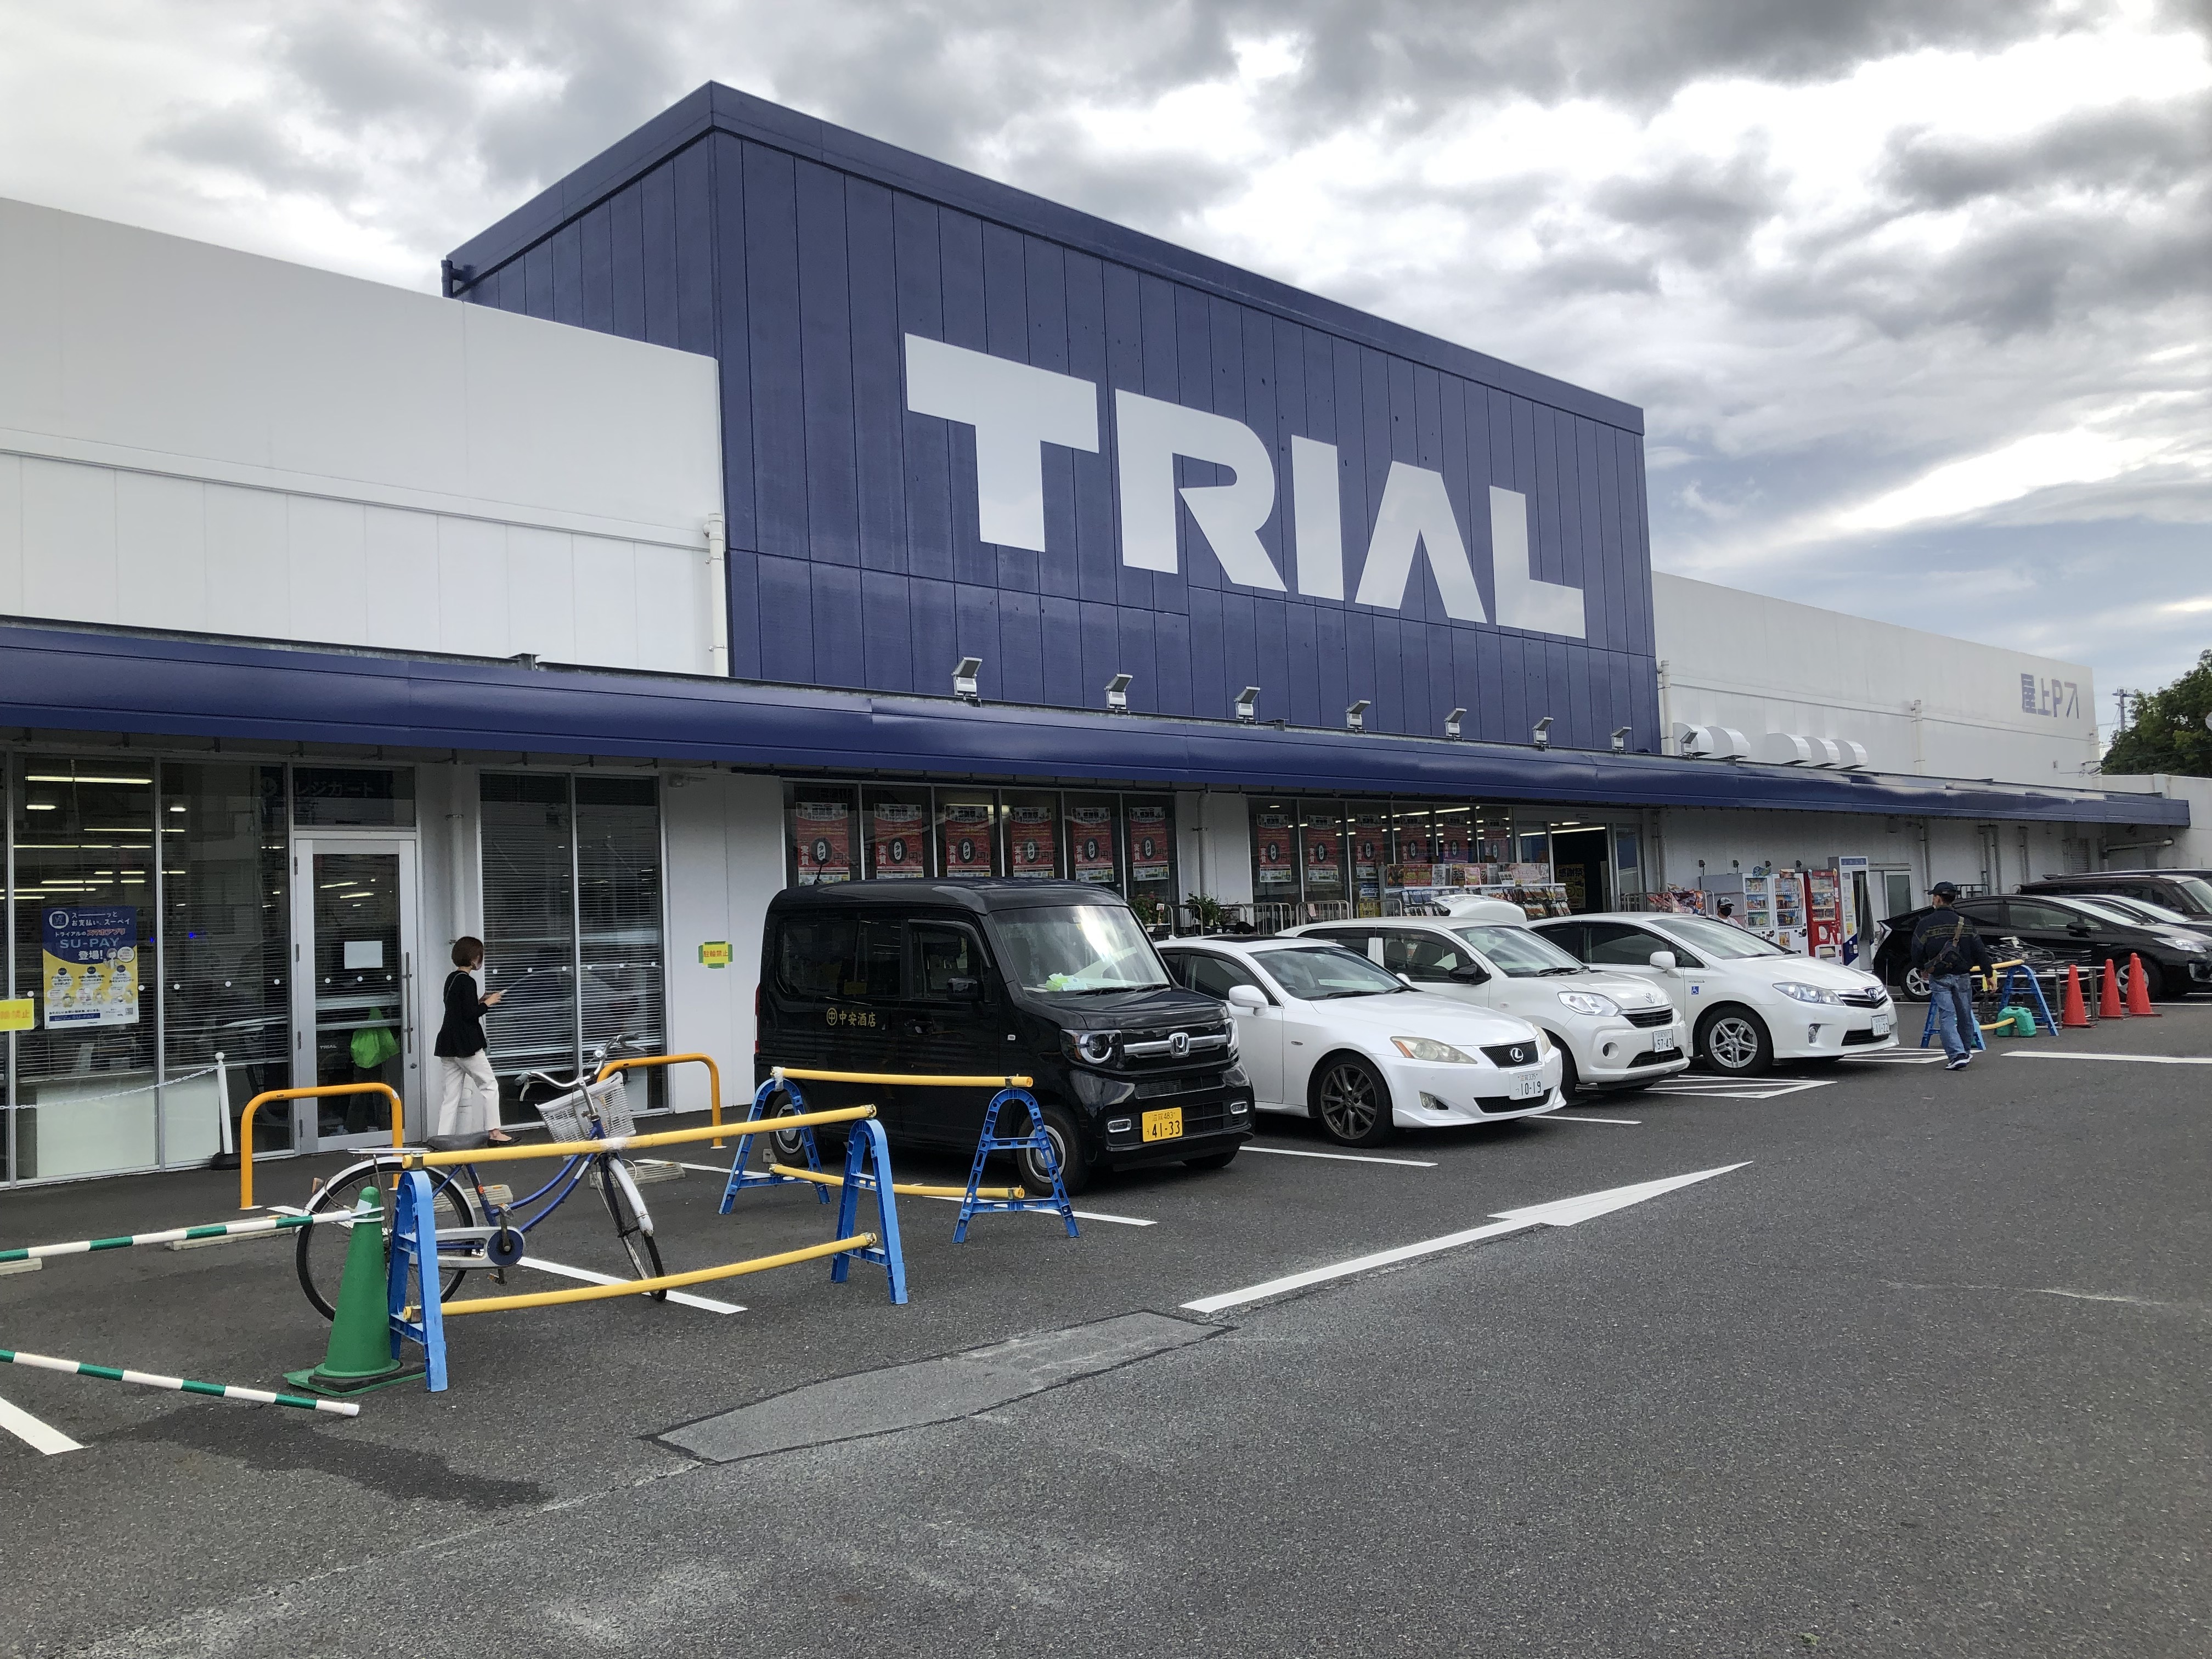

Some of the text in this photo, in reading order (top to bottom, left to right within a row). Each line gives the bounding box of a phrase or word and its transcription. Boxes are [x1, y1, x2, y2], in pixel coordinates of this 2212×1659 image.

[904, 333, 1586, 639] TRIAL
[800, 845, 809, 865] 実質
[878, 845, 887, 865] 実質
[949, 845, 956, 864] 実質
[1015, 846, 1022, 864] 実質
[59, 937, 120, 949] SU-PAY
[703, 950, 729, 958] 駐輪禁止
[839, 1011, 876, 1027] 中安酒店
[1152, 1120, 1180, 1138] 41-33
